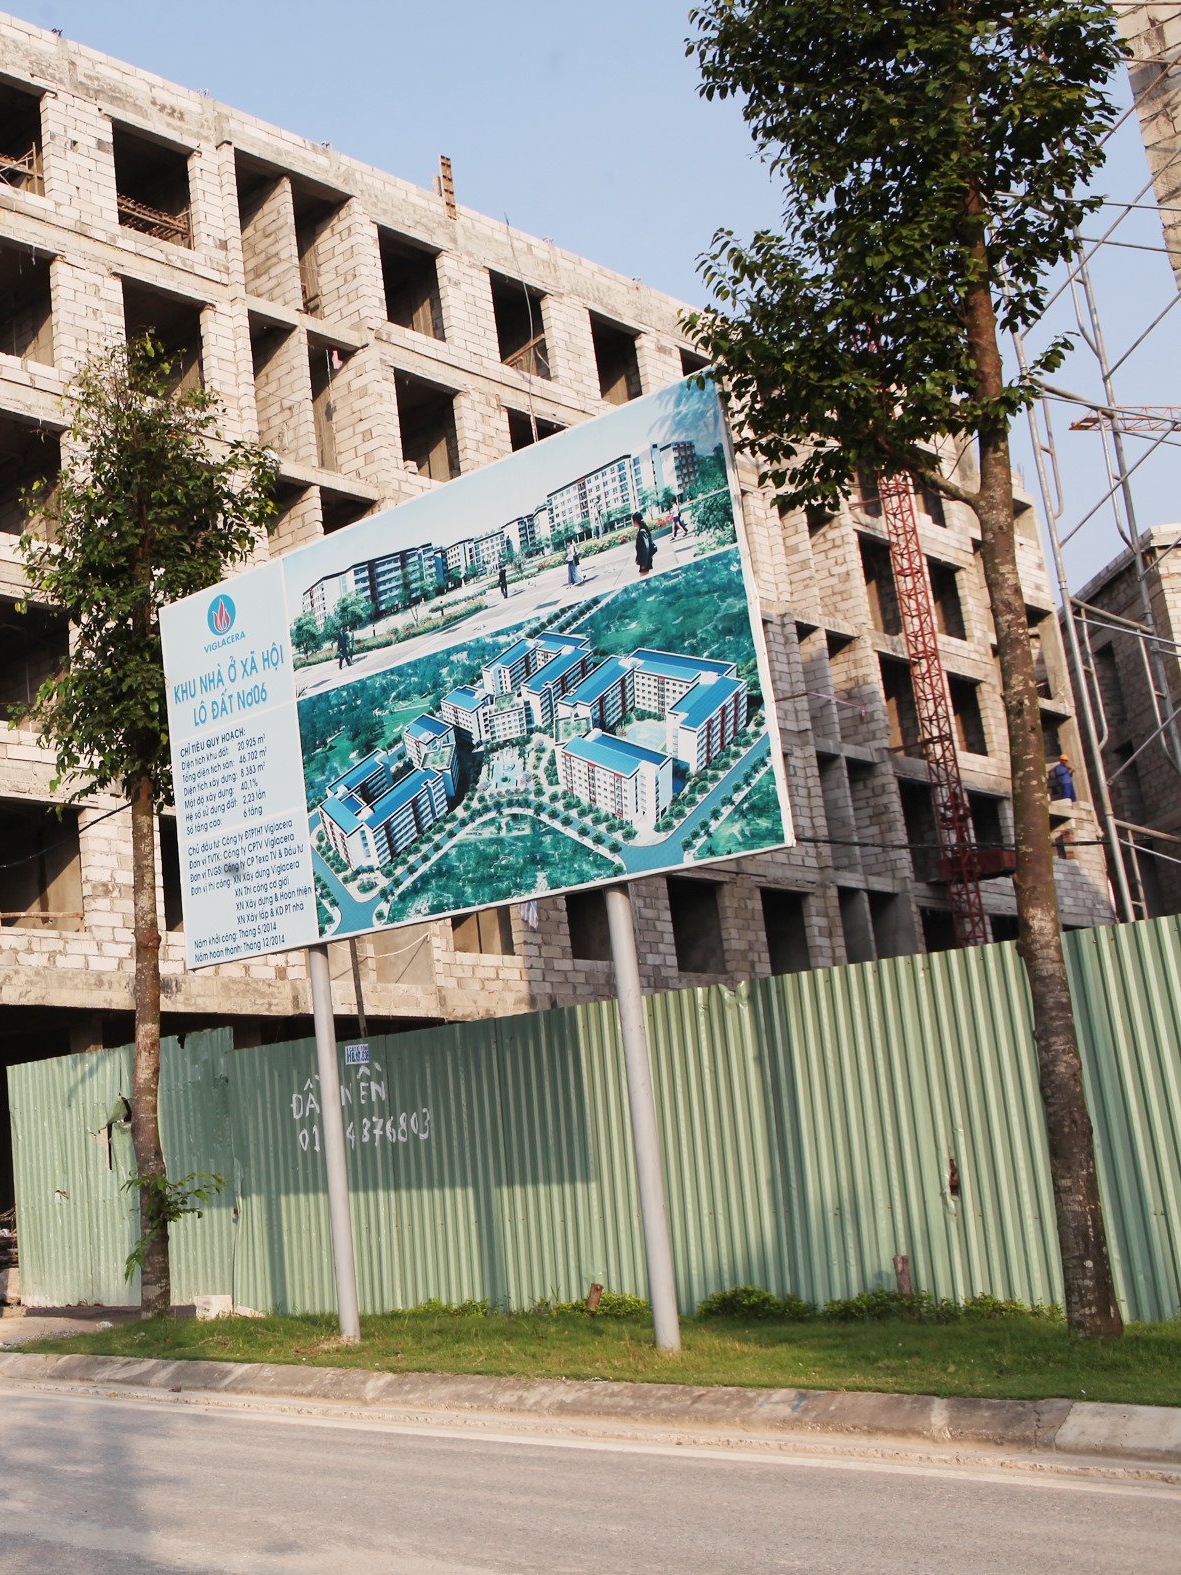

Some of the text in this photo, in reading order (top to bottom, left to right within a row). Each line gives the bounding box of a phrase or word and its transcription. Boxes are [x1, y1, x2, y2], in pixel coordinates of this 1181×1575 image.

[204, 631, 246, 653] VIGLACERA
[174, 642, 284, 704] KHU NHÀ Ở XÃ HỘI
[193, 702, 207, 726] LÔ
[212, 688, 233, 720] ĐẤT
[180, 727, 245, 757] CHỈ TIÊU QUY HOẠCH:
